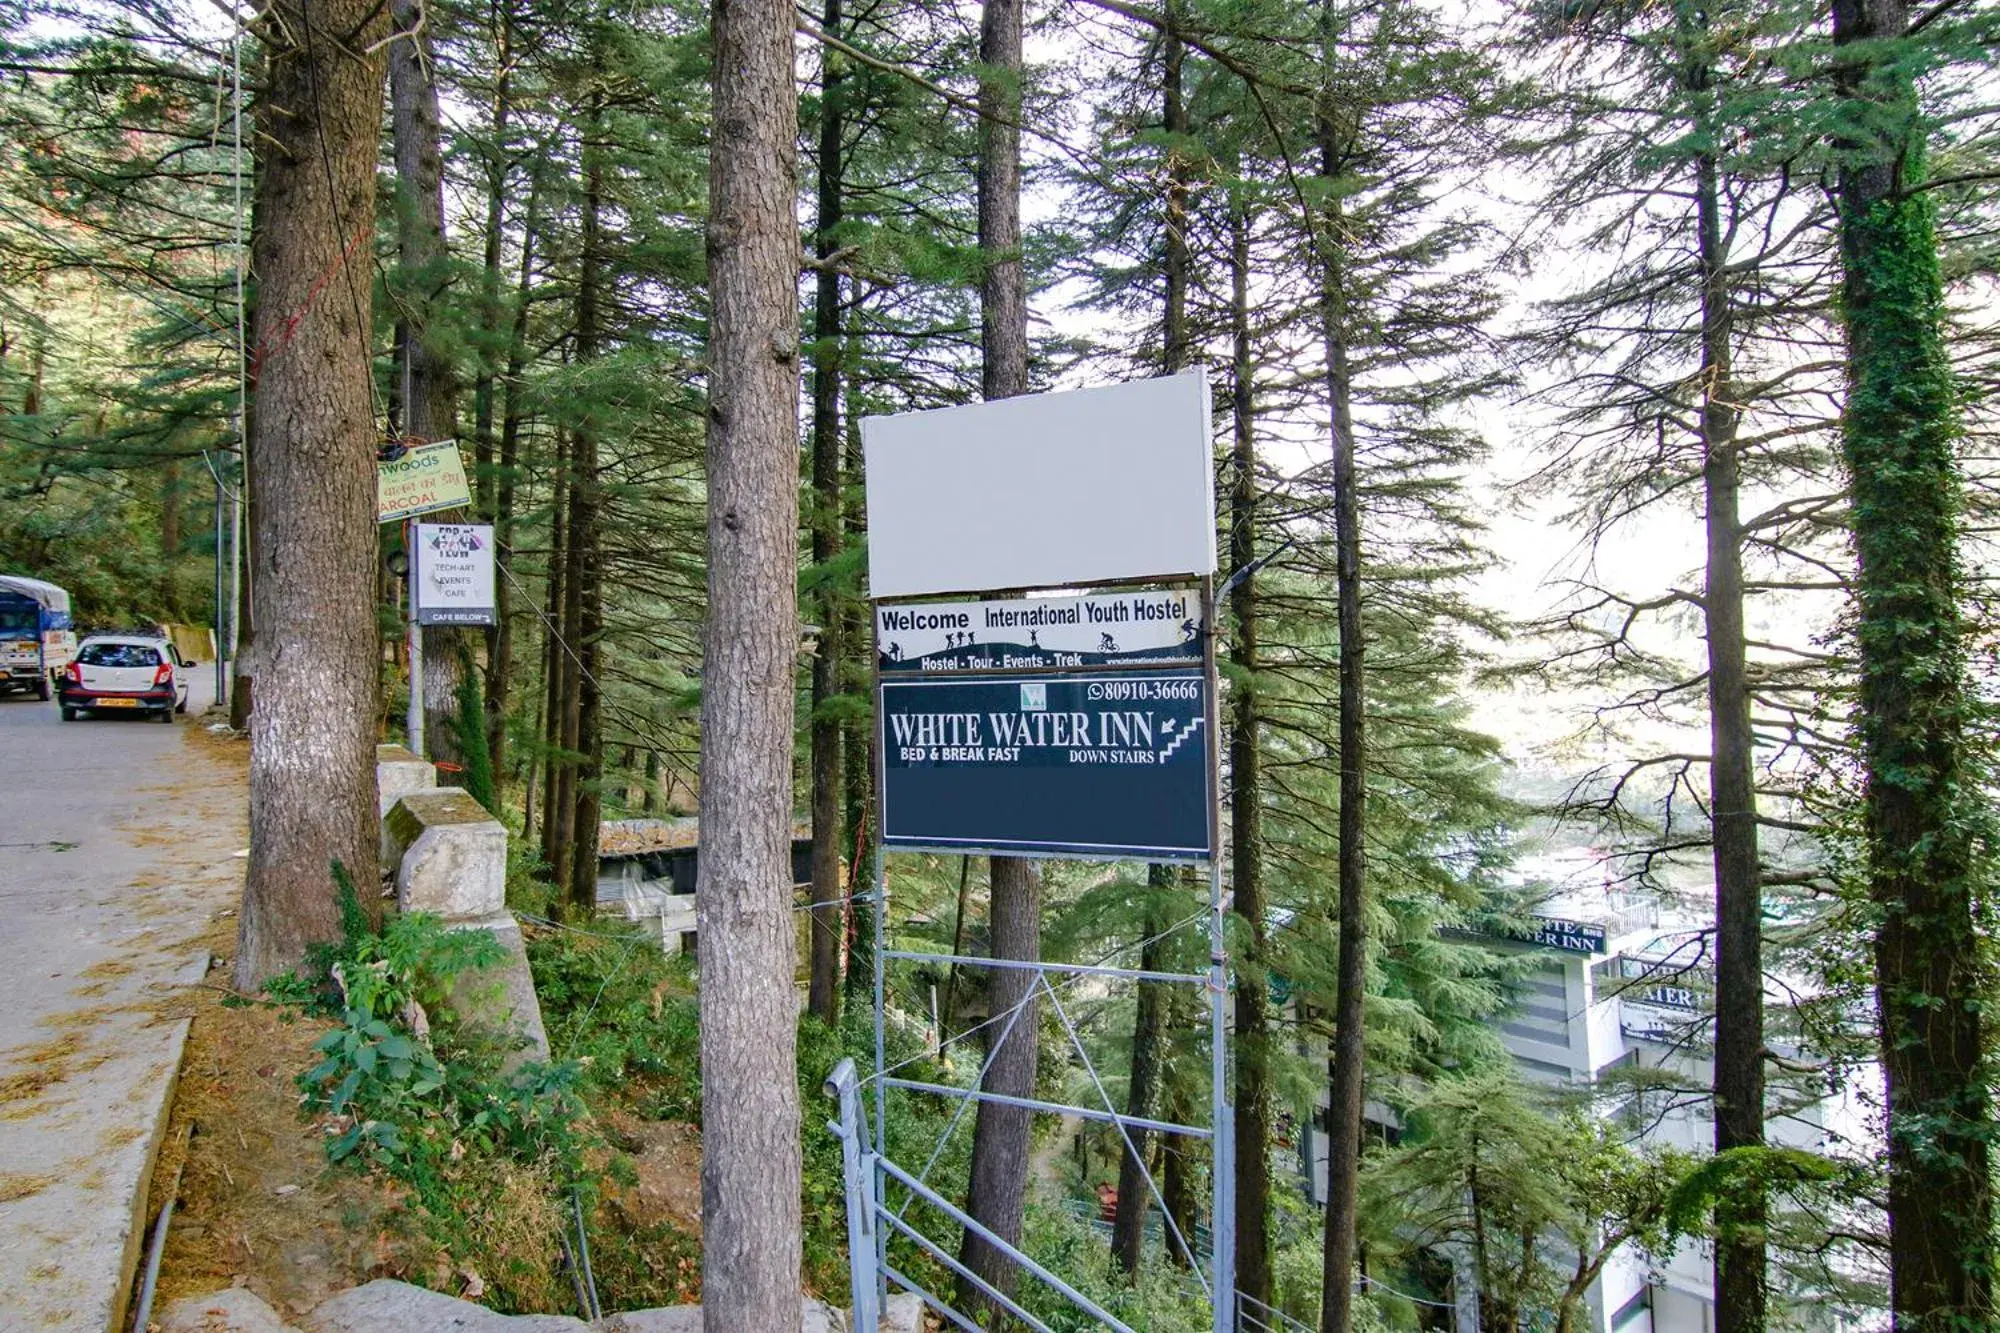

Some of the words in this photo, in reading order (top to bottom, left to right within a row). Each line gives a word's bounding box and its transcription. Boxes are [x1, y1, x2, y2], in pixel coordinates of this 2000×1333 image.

[439, 576, 472, 584] EVENTS
[882, 610, 969, 631] Welcome
[985, 602, 1080, 627] International
[1085, 601, 1129, 623] Youth
[1134, 597, 1187, 621] Hostel
[921, 656, 958, 671] Hostel
[967, 655, 993, 669] Tour
[1003, 654, 1043, 668] Events
[1053, 653, 1083, 667] Trek
[1104, 681, 1198, 700] 80910-36666
[890, 713, 983, 746] WHITE
[989, 712, 1092, 746] WATER
[1098, 711, 1154, 747] INN
[901, 748, 926, 761] BED
[930, 748, 940, 761] &
[942, 747, 985, 761] BREAK
[988, 747, 1021, 761] FAST
[1069, 750, 1107, 763] DOWN
[1110, 750, 1155, 763] STAIRS
[1562, 935, 1595, 950] INN
